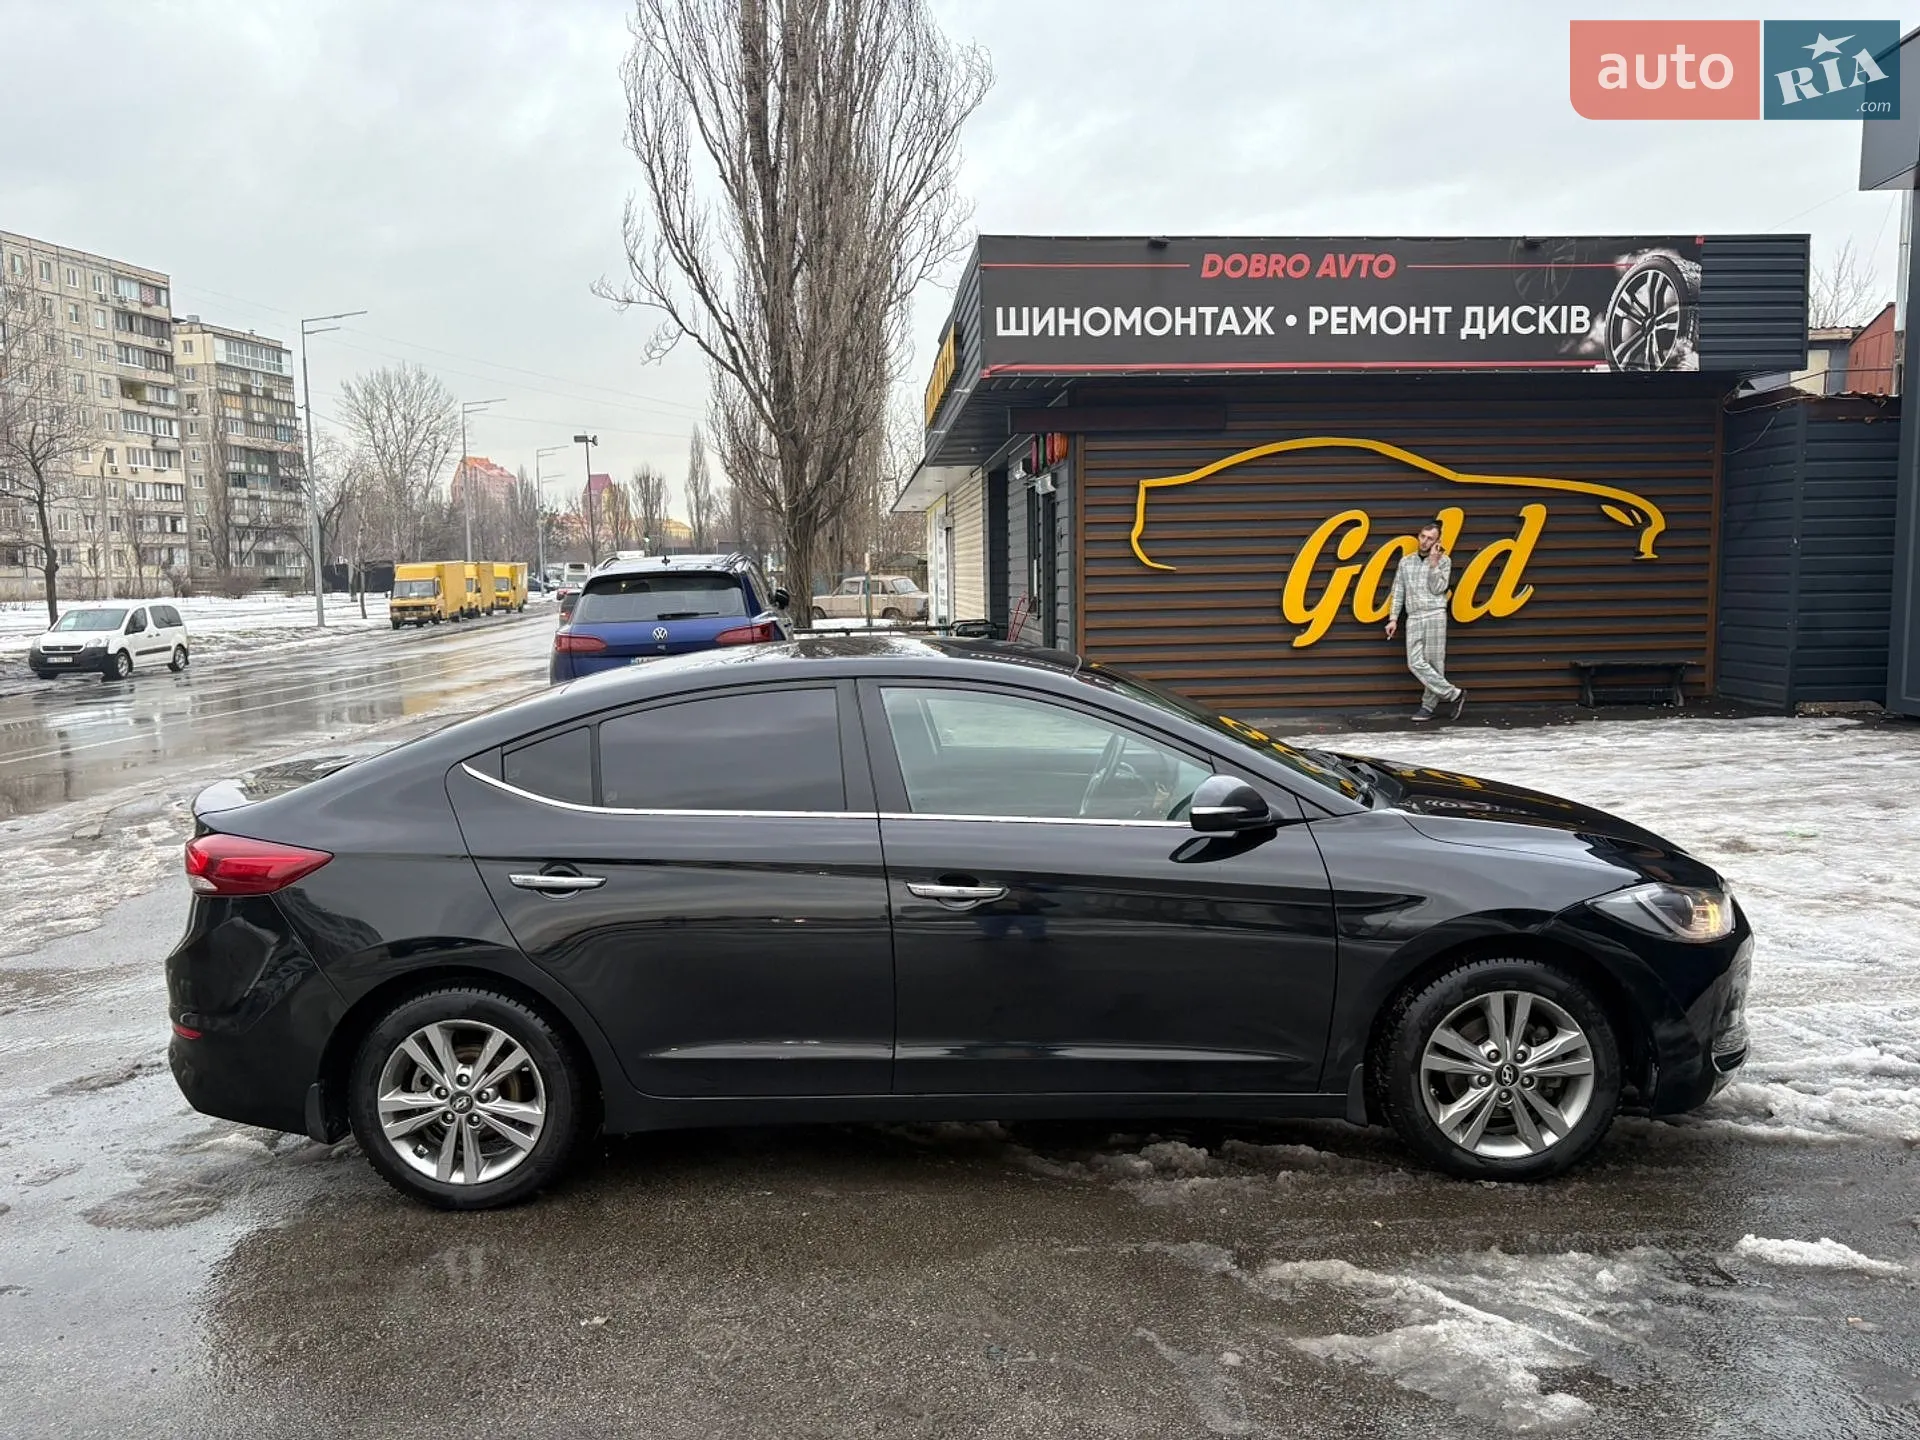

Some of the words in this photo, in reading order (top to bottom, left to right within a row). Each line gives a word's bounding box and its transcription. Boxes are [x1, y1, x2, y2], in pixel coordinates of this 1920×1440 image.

[1201, 253, 1311, 279] DOBRO
[1316, 253, 1397, 279] AVTO
[995, 306, 1275, 337] ШИНОМОНТАЖ
[1308, 305, 1453, 336] РЕМОНТ
[1459, 305, 1592, 339] ДИСКІВ
